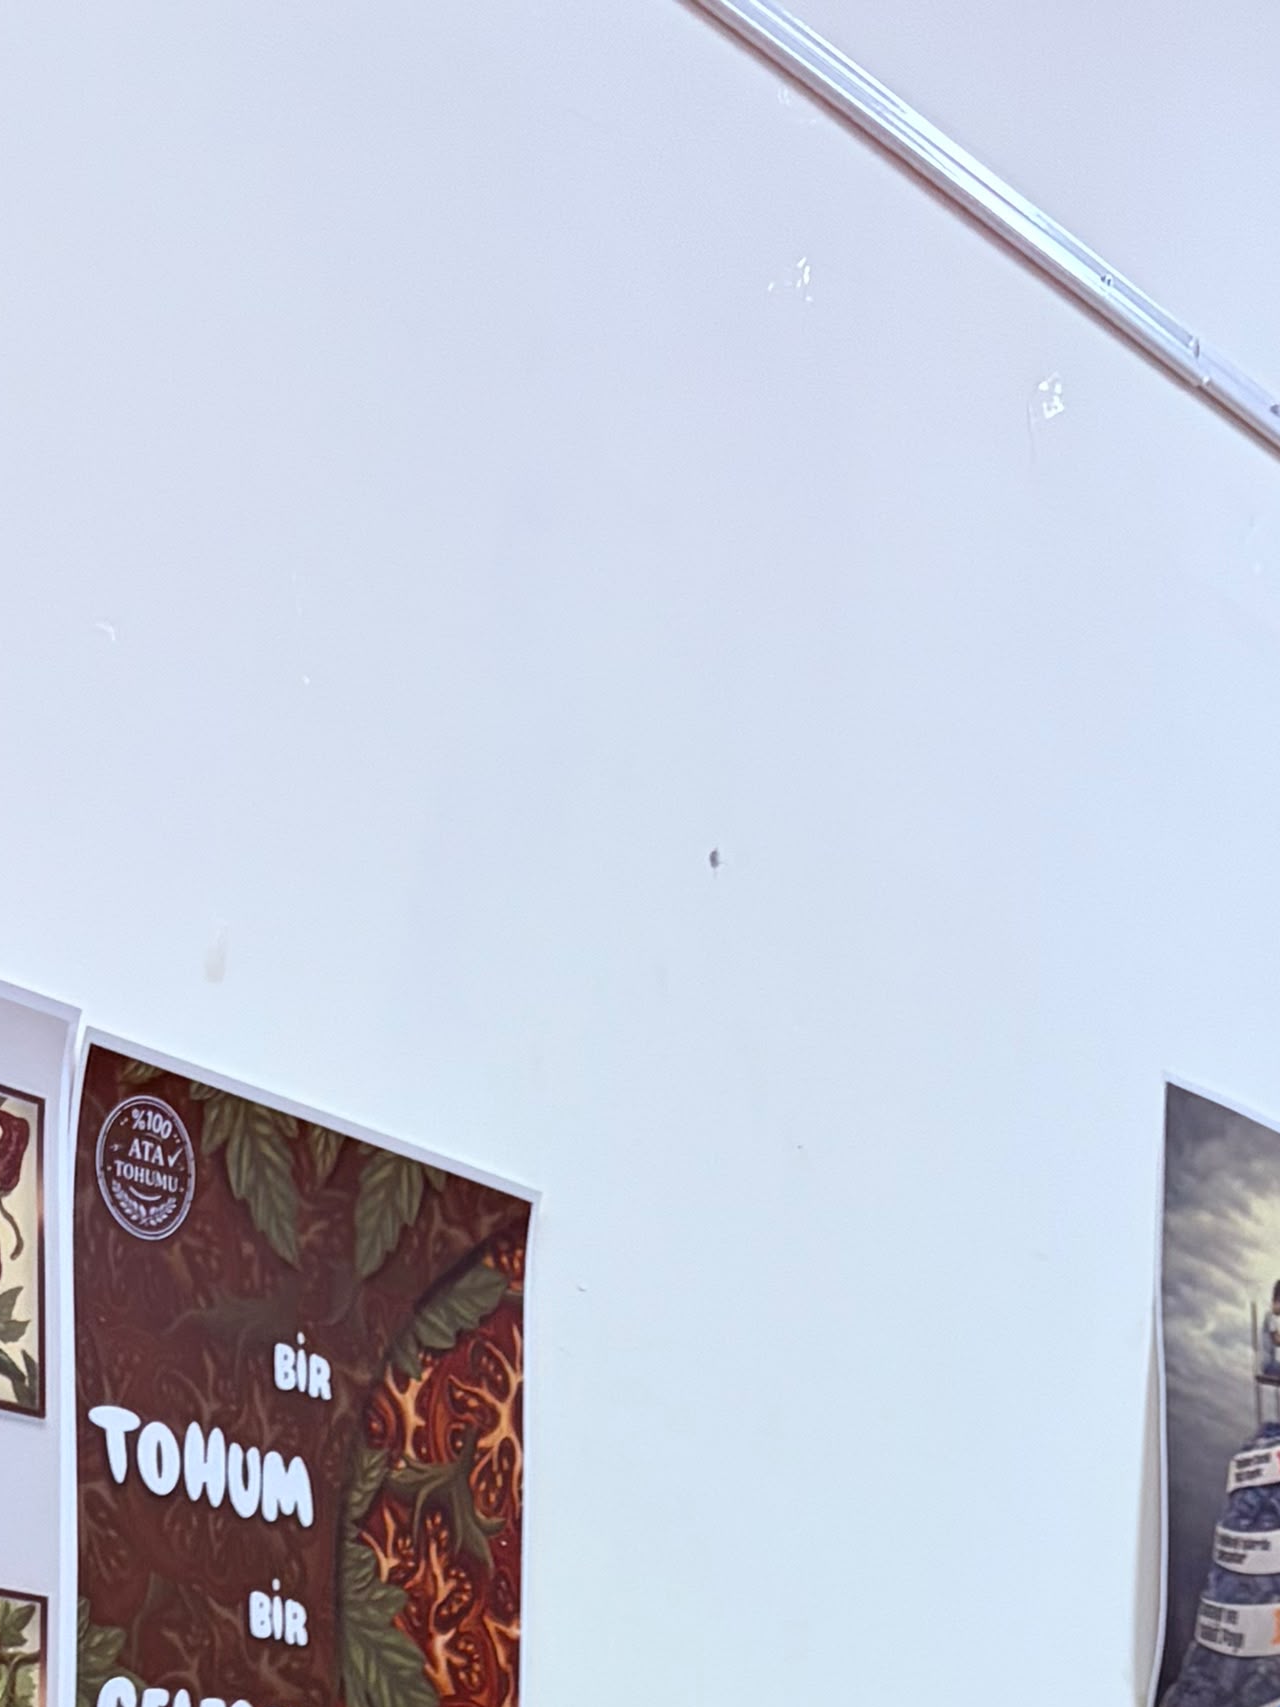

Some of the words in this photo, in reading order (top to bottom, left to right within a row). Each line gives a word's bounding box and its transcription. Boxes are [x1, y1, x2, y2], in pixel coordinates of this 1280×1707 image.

[131, 1108, 173, 1140] %100
[114, 1160, 178, 1193] TOHUMU
[128, 1138, 165, 1166] ATA
[273, 1332, 332, 1400] BİR
[88, 1405, 315, 1528] TOHUM
[248, 1578, 309, 1648] BİR
